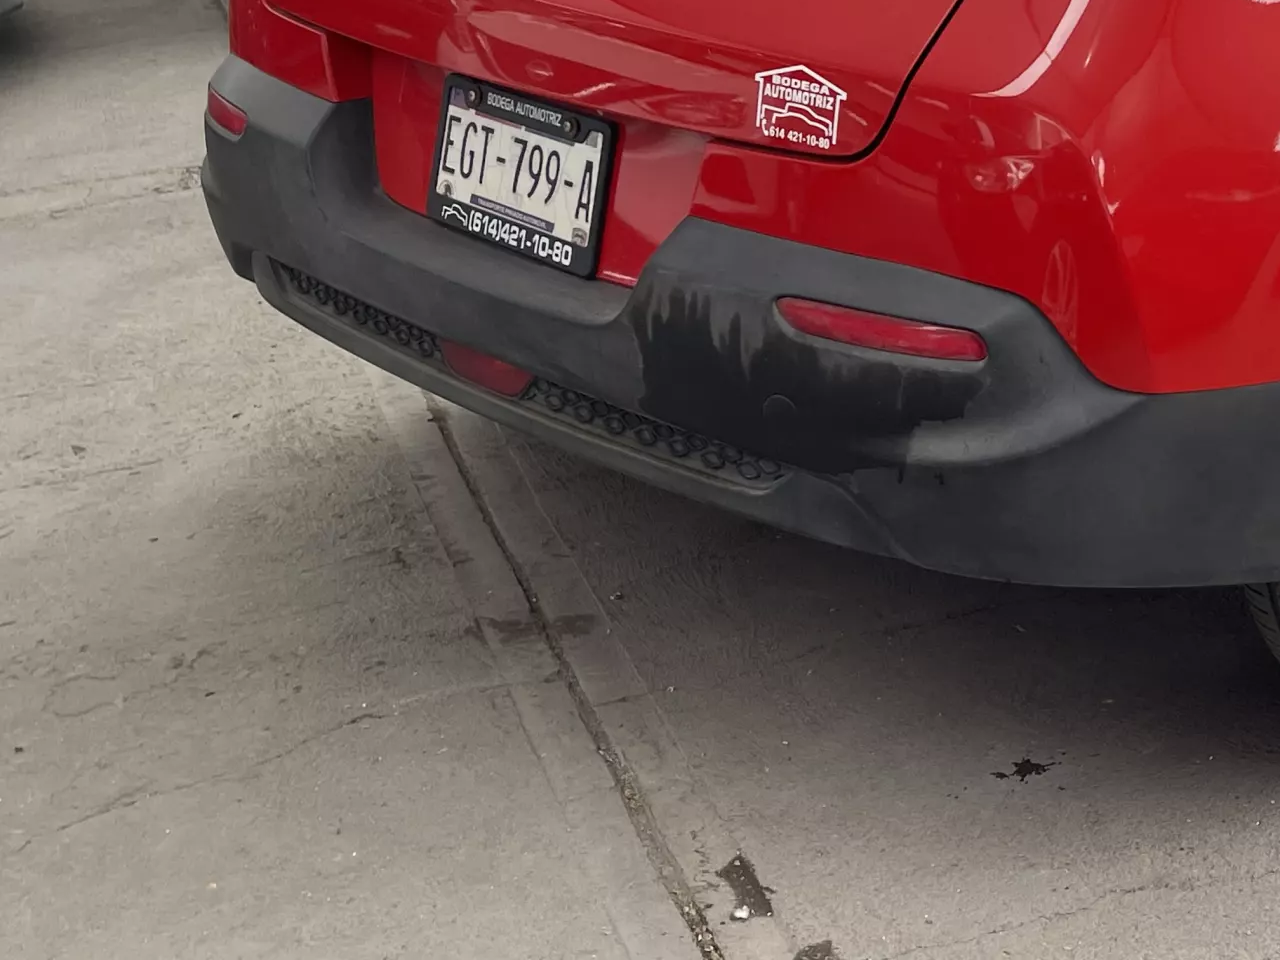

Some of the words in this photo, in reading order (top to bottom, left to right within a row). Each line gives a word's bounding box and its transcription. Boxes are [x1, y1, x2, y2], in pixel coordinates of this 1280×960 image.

[764, 83, 835, 111] AUTOMOTRIZ
[772, 74, 830, 96] BODEGA
[487, 92, 515, 113] BODEGA
[515, 102, 562, 127] AUTOMOTRIZ
[769, 126, 785, 140] 614
[786, 131, 830, 150] 421-10-80
[441, 114, 594, 223] EGT-799-A
[468, 210, 573, 266] (614)421-10-80
